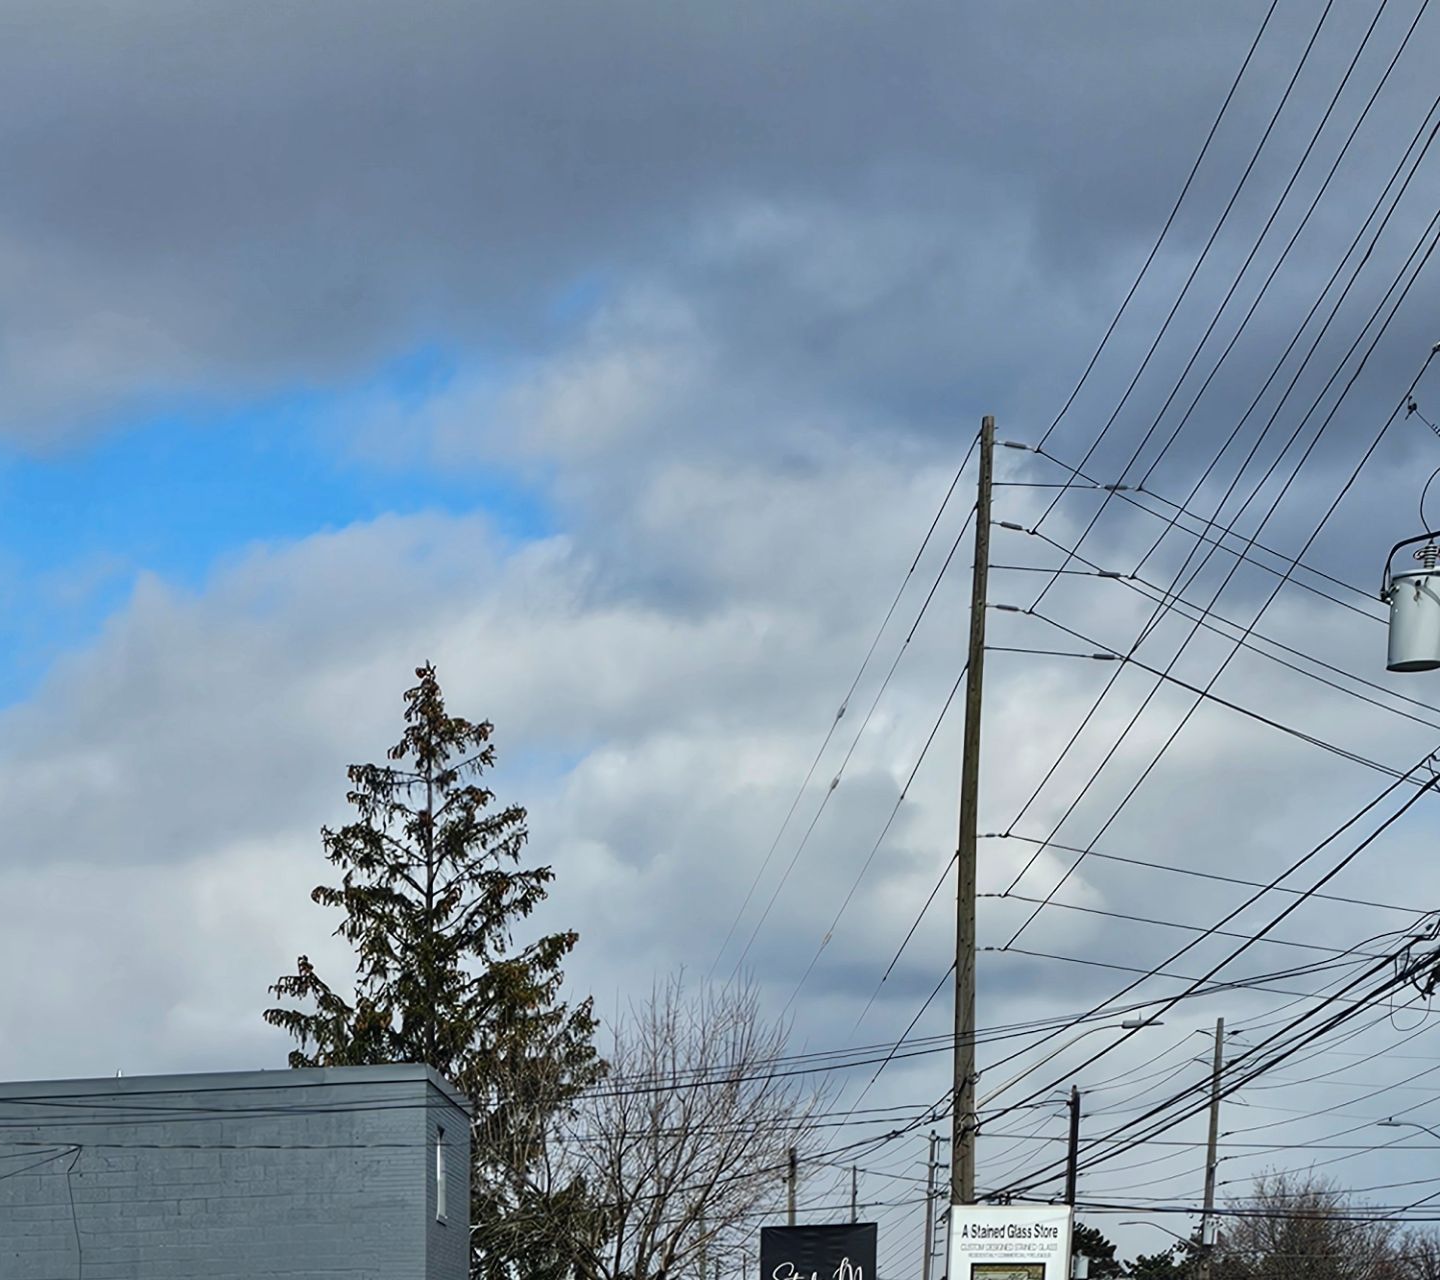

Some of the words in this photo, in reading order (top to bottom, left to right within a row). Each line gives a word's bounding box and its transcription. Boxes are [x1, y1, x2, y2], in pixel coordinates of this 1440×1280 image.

[962, 1224, 969, 1239] A
[971, 1223, 1005, 1239] Stained
[1007, 1223, 1032, 1239] Glass
[1034, 1223, 1058, 1239] Store
